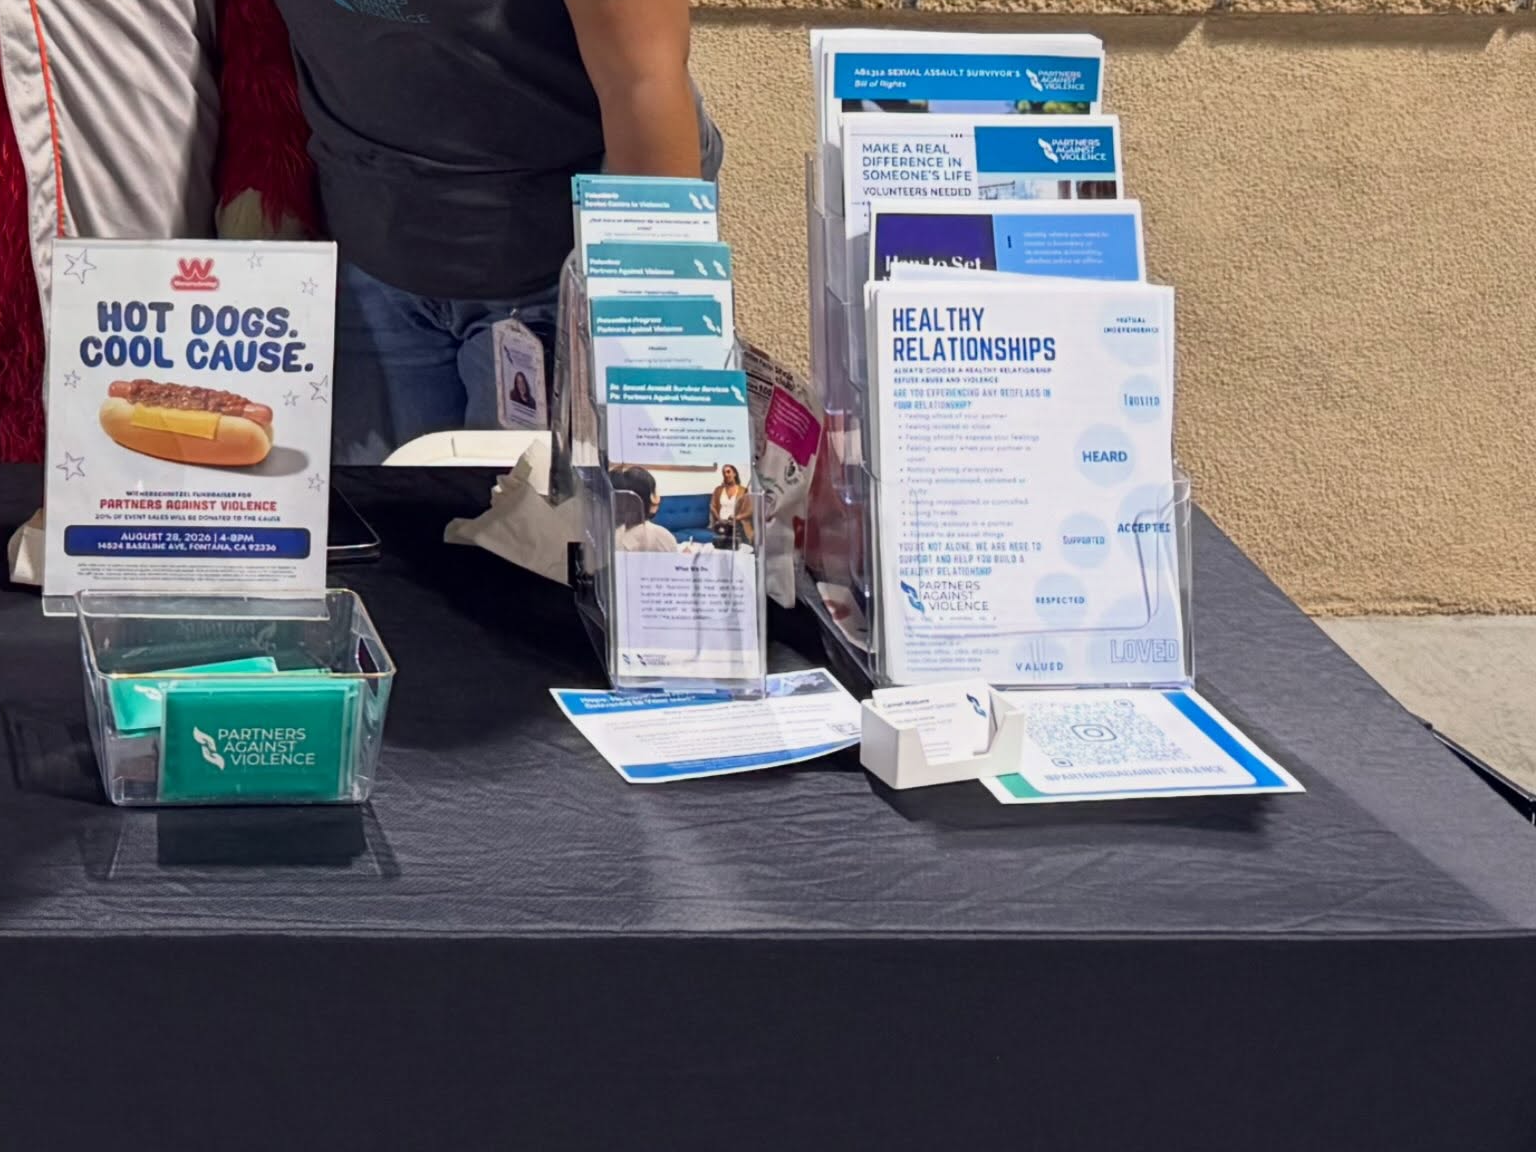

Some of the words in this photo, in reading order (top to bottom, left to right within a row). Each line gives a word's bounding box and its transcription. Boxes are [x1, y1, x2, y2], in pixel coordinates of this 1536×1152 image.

[887, 68, 921, 77] SEXUAL
[924, 68, 964, 77] ASSAULT
[1038, 70, 1081, 78] PARTNERS
[868, 80, 878, 88] of
[1043, 83, 1084, 91] VIOLENCE
[1052, 139, 1101, 147] PARTNERS
[863, 144, 900, 154] MAKE
[904, 144, 913, 154] A
[916, 144, 949, 154] REAL
[1056, 146, 1095, 154] AGAINST
[1060, 152, 1106, 161] VIOLENCE
[863, 157, 944, 167] DIFFERENCE
[948, 157, 962, 167] IN
[863, 170, 940, 181] SOMEONE'S
[944, 171, 972, 181] LIFE
[863, 187, 928, 196] VOLUNTEERS
[931, 187, 971, 196] NEEDED
[178, 258, 214, 280] W
[97, 301, 174, 333] HOT
[190, 303, 298, 338] DOGS.
[892, 307, 985, 332] HEALTHY
[893, 337, 1056, 361] RELATIONSHIPS
[79, 336, 174, 368] COOL
[185, 338, 313, 373] CAUSE.
[965, 367, 997, 375] HEALTHY
[654, 393, 679, 403] Against
[982, 388, 997, 398] ANY
[1082, 450, 1128, 463] HEARD
[100, 499, 162, 510] PARTNERS
[166, 499, 216, 511] AGAINST
[220, 500, 277, 512] VIOLENCE
[121, 532, 163, 542] AUGUST
[166, 532, 181, 543] 28,
[184, 533, 211, 542] 2026
[220, 533, 254, 543] 4-8PM
[126, 541, 166, 551] BASELINE
[168, 542, 186, 551] AVE,
[189, 542, 231, 552] FONTANA,
[233, 543, 247, 551] CA
[928, 542, 942, 551] NOT
[976, 542, 988, 551] WE
[991, 542, 1007, 551] ARE
[1032, 542, 1042, 551] TO
[936, 554, 951, 563] AND
[953, 554, 973, 563] HELP
[994, 554, 1017, 563] BUILD
[899, 567, 934, 576] HEALTHY
[937, 566, 992, 576] RELATIONSHIP
[919, 581, 980, 590] PARTNERS
[923, 591, 973, 600] AGAINST
[1036, 596, 1085, 605] RESPECTED
[928, 601, 989, 611] VIOLENCE
[1110, 639, 1180, 664] LOVED
[1016, 662, 1064, 672] VALUED
[218, 728, 306, 740] PARTNERS
[223, 740, 297, 752] AGAINST
[232, 753, 315, 765] VIOLENCE
